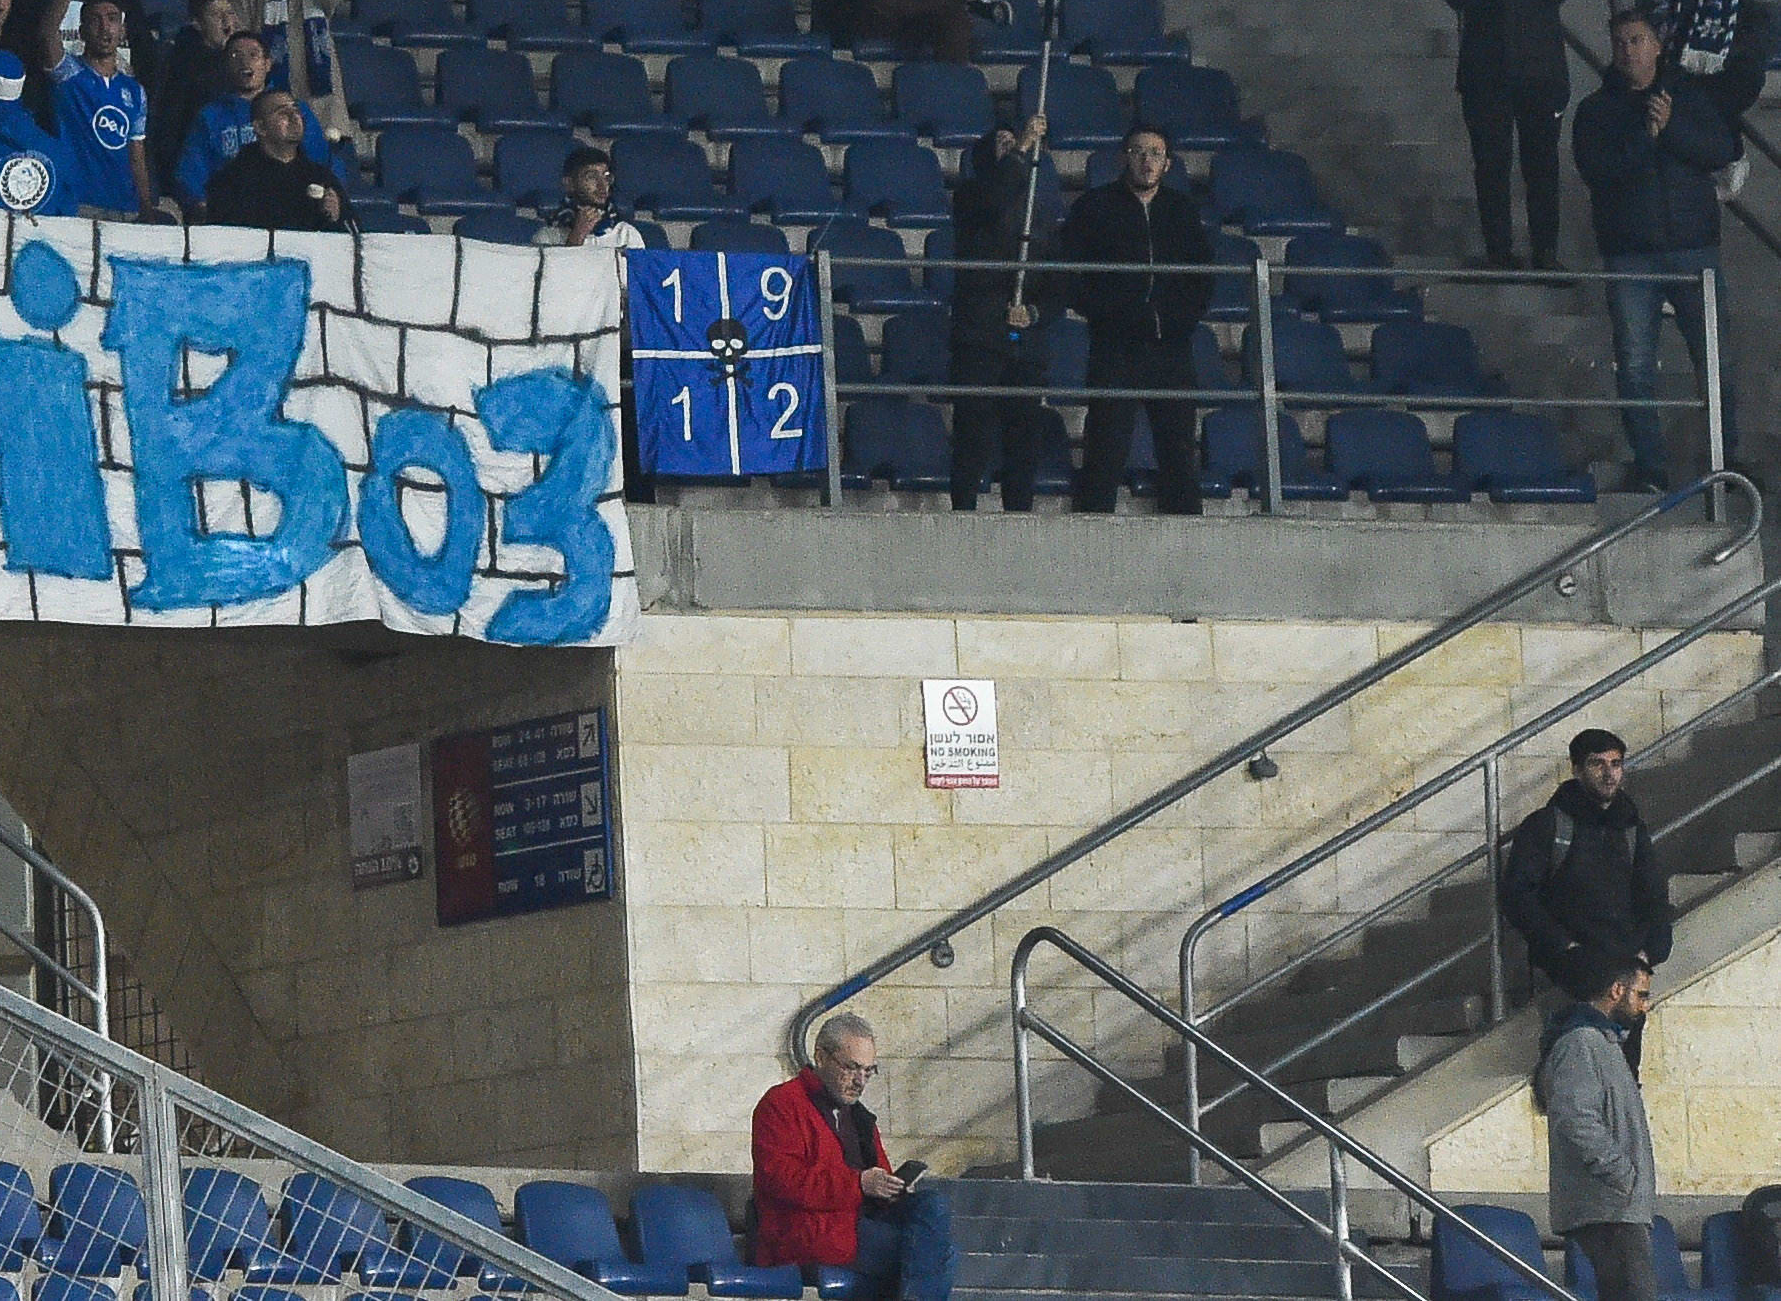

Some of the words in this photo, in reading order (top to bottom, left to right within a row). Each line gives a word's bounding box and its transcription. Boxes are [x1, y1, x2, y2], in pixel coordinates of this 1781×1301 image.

[662, 267, 682, 323] 1
[760, 266, 793, 321] 9
[671, 385, 692, 442] 1
[768, 381, 803, 440] 2
[930, 730, 961, 746] לעשן
[966, 733, 995, 744] אסור
[930, 747, 945, 757] NO
[948, 747, 996, 757] SMOKING
